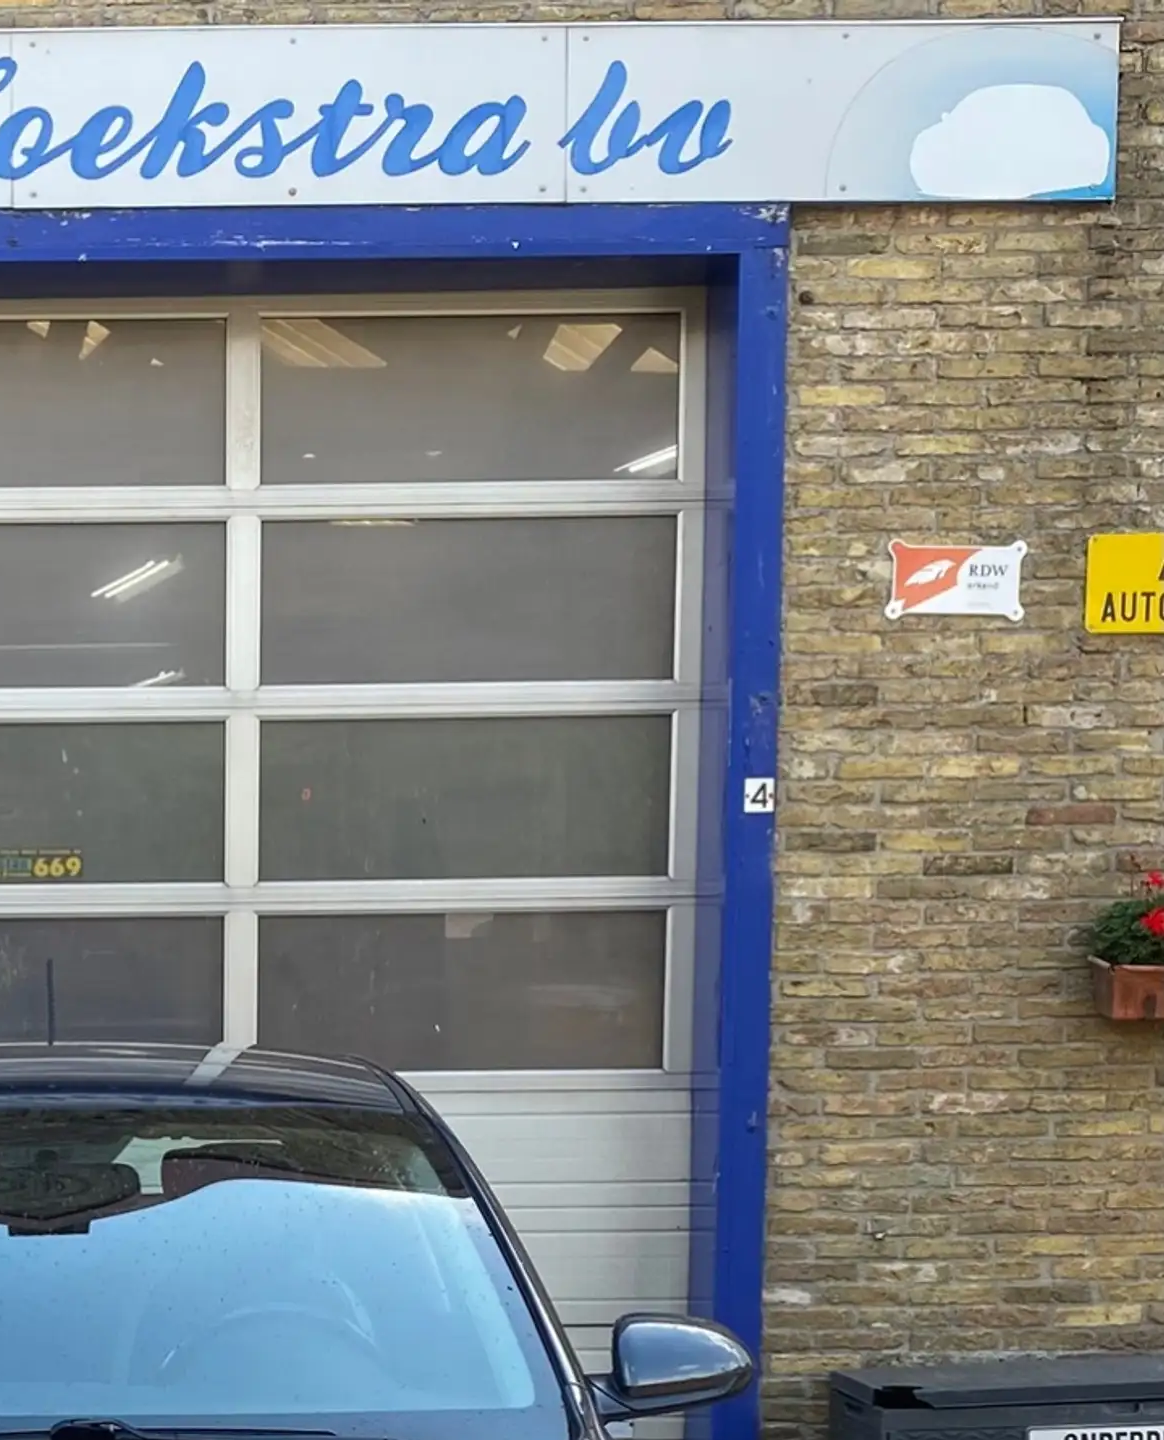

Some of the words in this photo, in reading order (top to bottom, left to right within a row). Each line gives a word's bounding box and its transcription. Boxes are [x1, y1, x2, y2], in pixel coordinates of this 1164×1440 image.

[559, 60, 733, 174] bv
[968, 563, 1008, 577] RDW
[750, 782, 768, 808] 4
